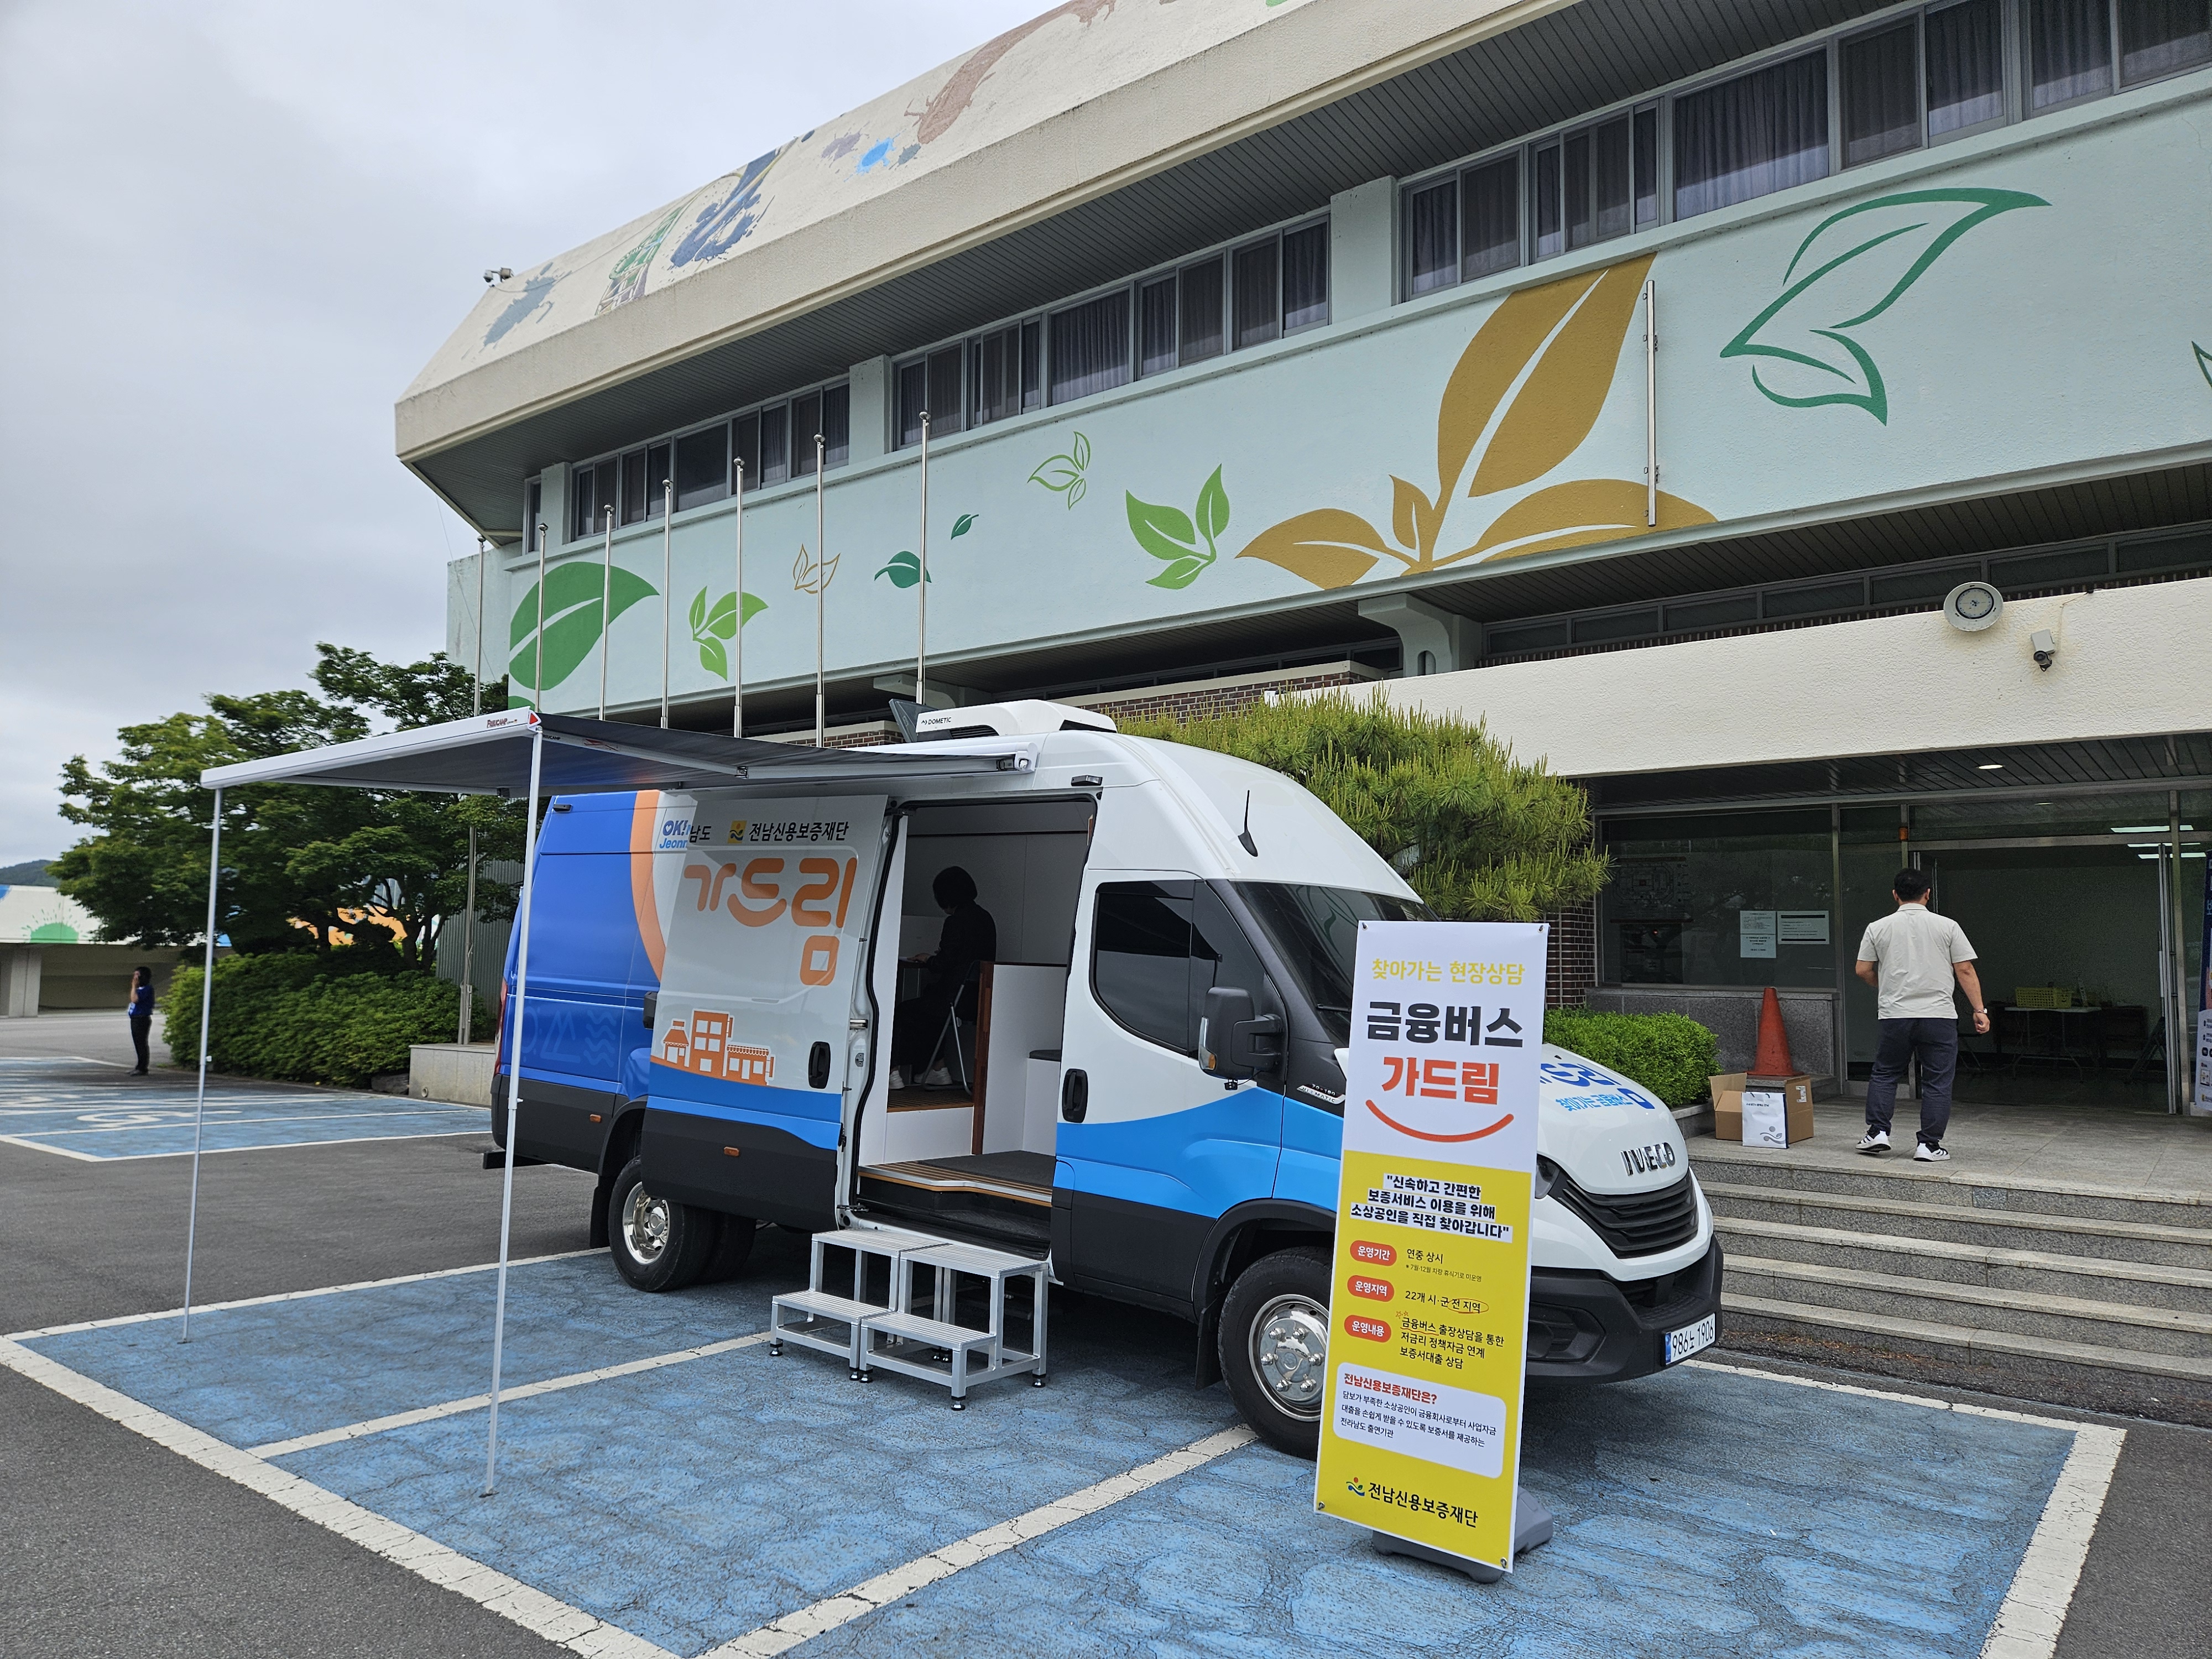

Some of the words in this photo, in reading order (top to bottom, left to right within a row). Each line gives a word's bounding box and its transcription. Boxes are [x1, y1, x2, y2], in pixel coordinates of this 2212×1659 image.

[662, 820, 688, 836] OK!
[690, 825, 711, 843] 남도
[749, 821, 849, 842] 전남신용보증재단
[684, 857, 858, 986] 가드림
[1372, 958, 1442, 982] 찾아가는
[1449, 961, 1525, 985] 현장상담
[1367, 1001, 1523, 1047] 금융버스
[1381, 1057, 1499, 1105] 가드림
[1541, 1063, 1655, 1109] 드림
[1556, 1095, 1601, 1112] 찾아가는
[1590, 1094, 1634, 1107] 금융버스
[1620, 1142, 1676, 1176] IVECO
[1387, 1175, 1439, 1194] "신속하고
[1444, 1182, 1481, 1199] 간편한
[1368, 1189, 1426, 1209] 보증서비스
[1431, 1198, 1467, 1215] 이용을
[1470, 1204, 1495, 1219] 위해
[1351, 1204, 1409, 1224] 소상공인을
[1412, 1213, 1436, 1228] 직접
[1439, 1217, 1509, 1238] 찾아갑니다"
[1358, 1246, 1390, 1261] 운영기간
[1407, 1249, 1423, 1260] 연중
[1426, 1253, 1443, 1264] 상시
[1355, 1281, 1387, 1296] 운영지역
[1444, 1270, 1464, 1279] 휴식기로
[1405, 1291, 1425, 1303] 22개
[1452, 1299, 1460, 1310] 전
[1463, 1301, 1480, 1313] 지역
[1352, 1321, 1384, 1337] 운영내용
[1402, 1317, 1436, 1332] 금융버스
[1439, 1324, 1483, 1343] 출장상담을
[1486, 1334, 1504, 1347] 통한
[1401, 1332, 1426, 1346] 저금리
[1429, 1337, 1464, 1354] 정책자금
[1467, 1345, 1485, 1359] 연계
[1698, 1318, 1714, 1346] 1906
[1400, 1347, 1443, 1365] 보증서대출
[1446, 1356, 1463, 1369] 상담
[1344, 1373, 1437, 1404] 전남신용보증재단은?
[1340, 1417, 1366, 1430] 전라남도
[1368, 1424, 1394, 1438] 출연기관
[1342, 1405, 1361, 1416] 대출을
[1362, 1410, 1381, 1421] 손쉽게
[1383, 1414, 1396, 1425] 받을
[1397, 1418, 1404, 1427] 수
[1406, 1420, 1426, 1432] 있도록
[1427, 1426, 1455, 1440] 보증서를
[1457, 1433, 1485, 1447] 제공하는
[1343, 1391, 1361, 1402] 담보가
[1363, 1395, 1383, 1407] 부족한
[1384, 1401, 1417, 1416] 소상공인이
[1418, 1409, 1466, 1428] 금융회사로부터
[1468, 1422, 1496, 1436] 사업자금
[1368, 1483, 1478, 1528] 전남신용보증재단
